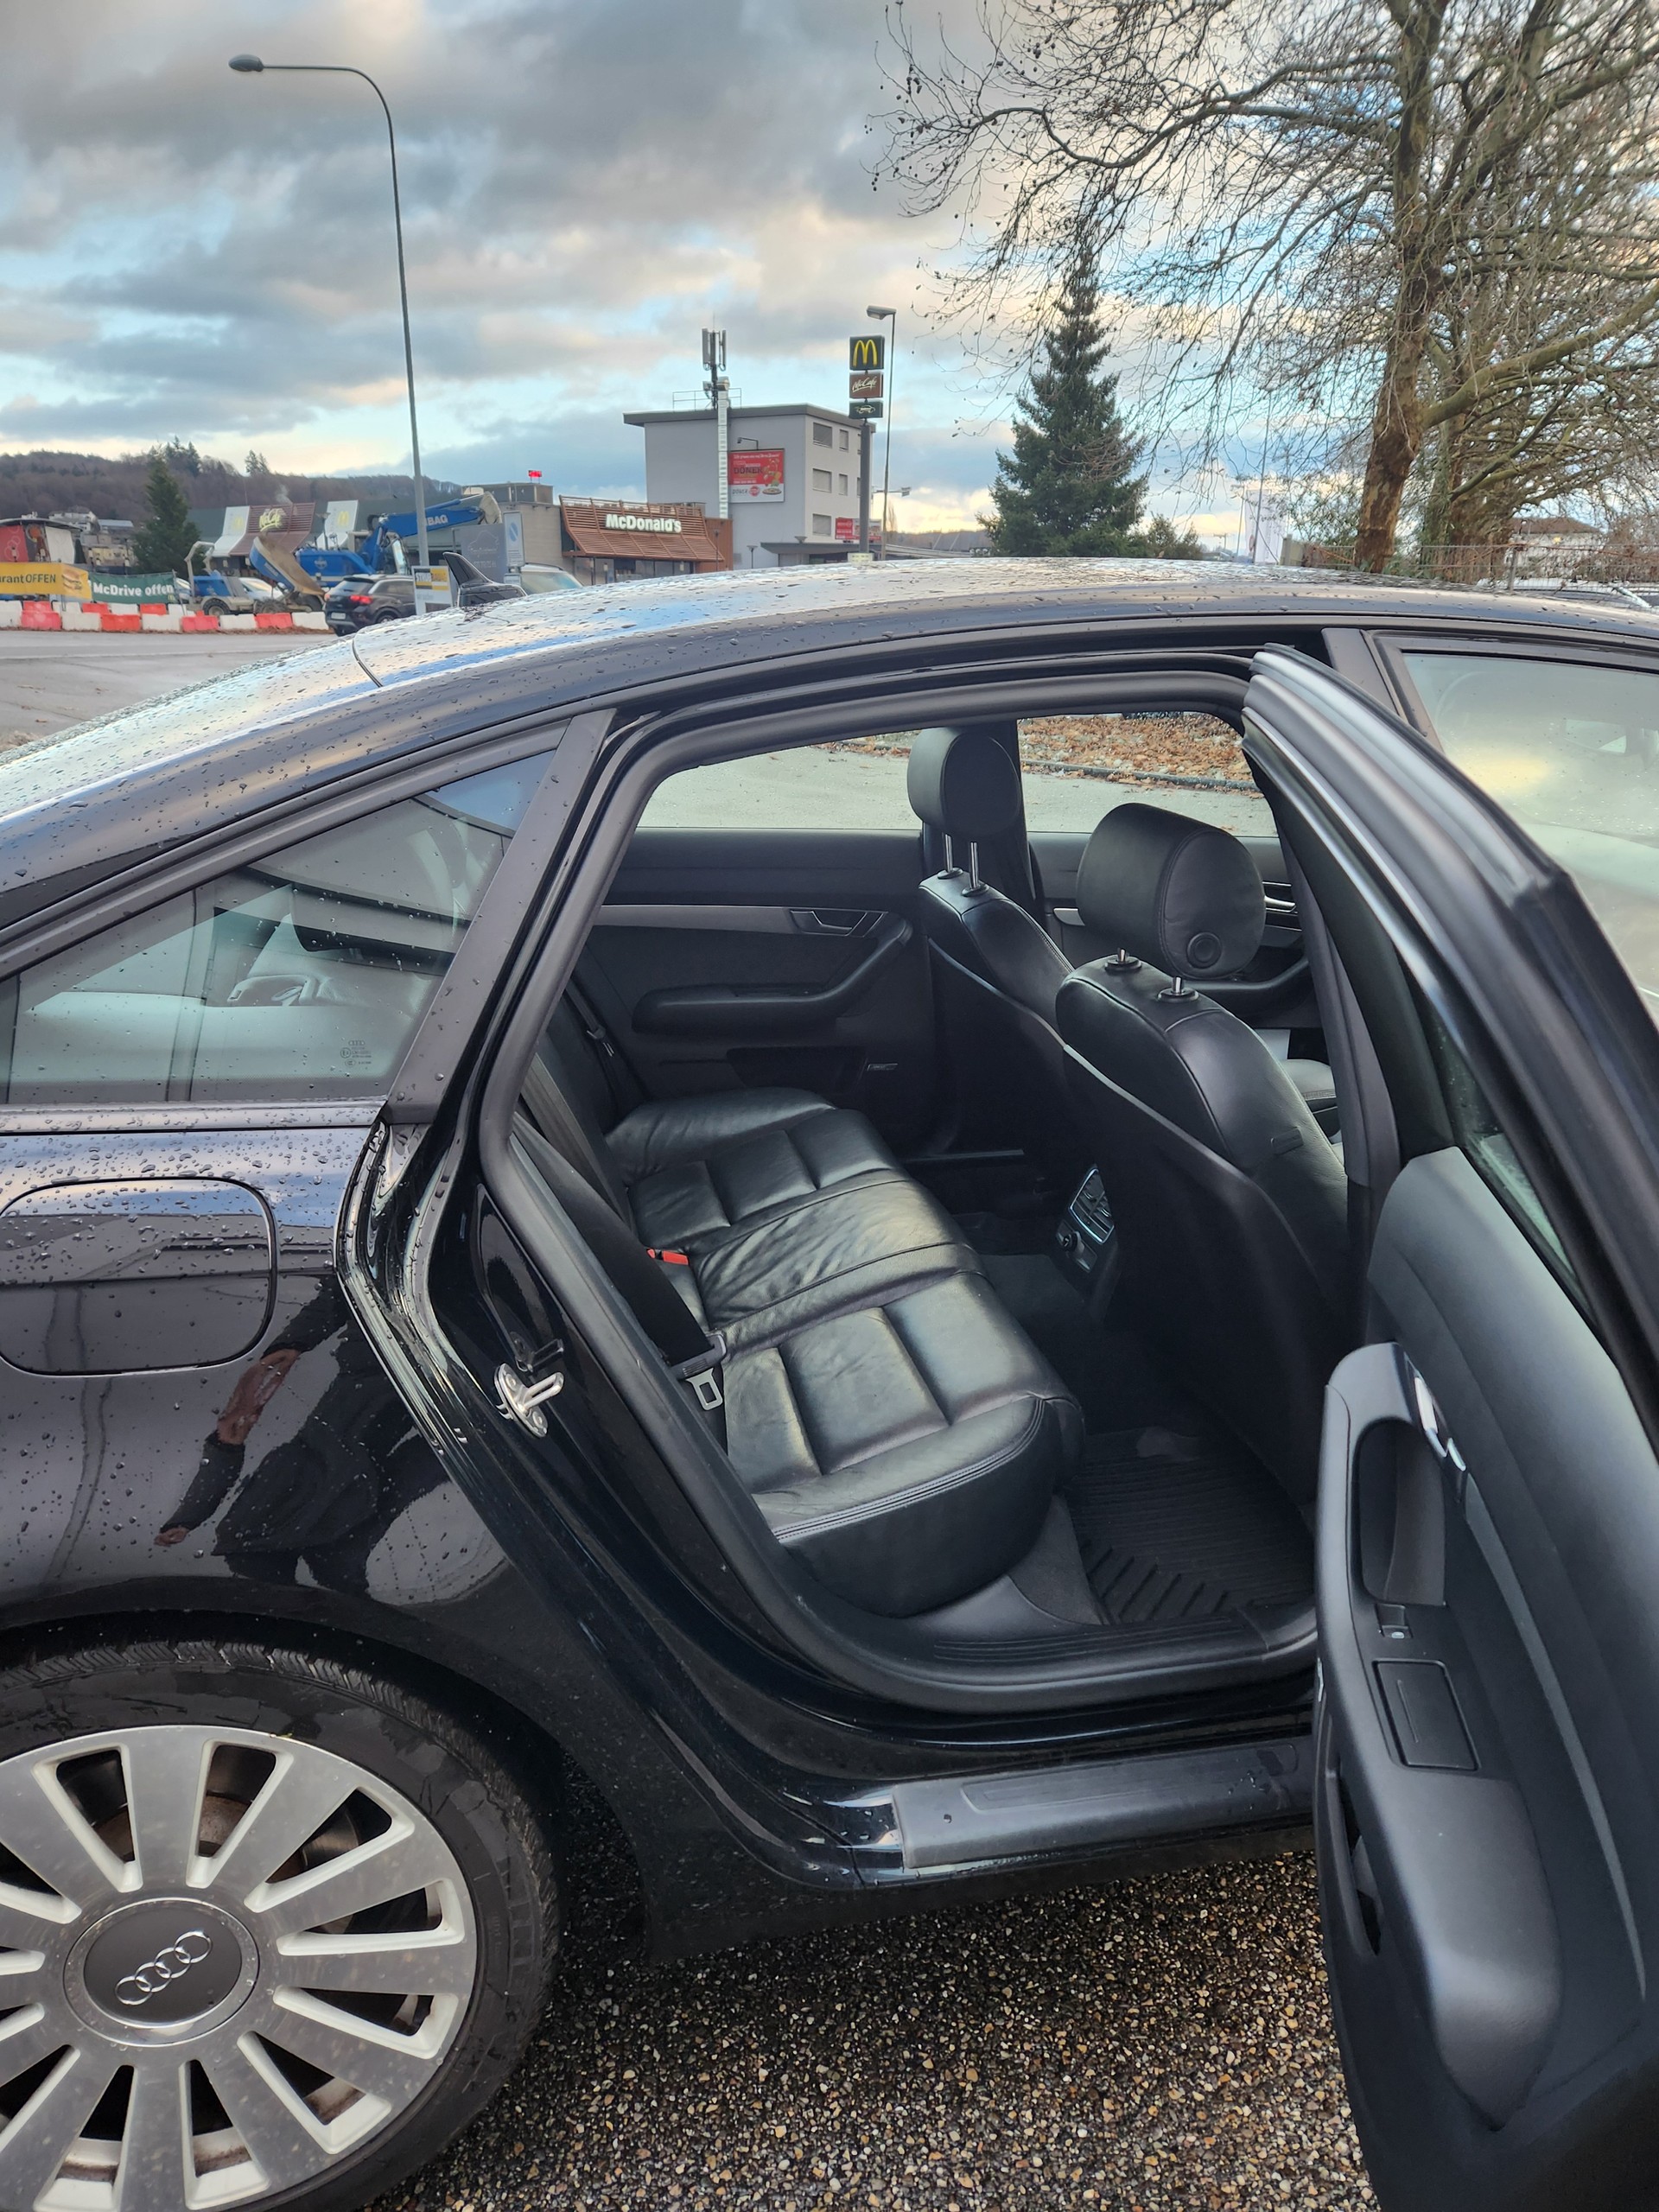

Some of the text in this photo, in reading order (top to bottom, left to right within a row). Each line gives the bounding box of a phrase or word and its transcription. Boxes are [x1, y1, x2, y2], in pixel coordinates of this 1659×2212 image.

[427, 514, 448, 526] BAG
[605, 513, 683, 534] McDonald's
[93, 582, 174, 596] McDrive offen
